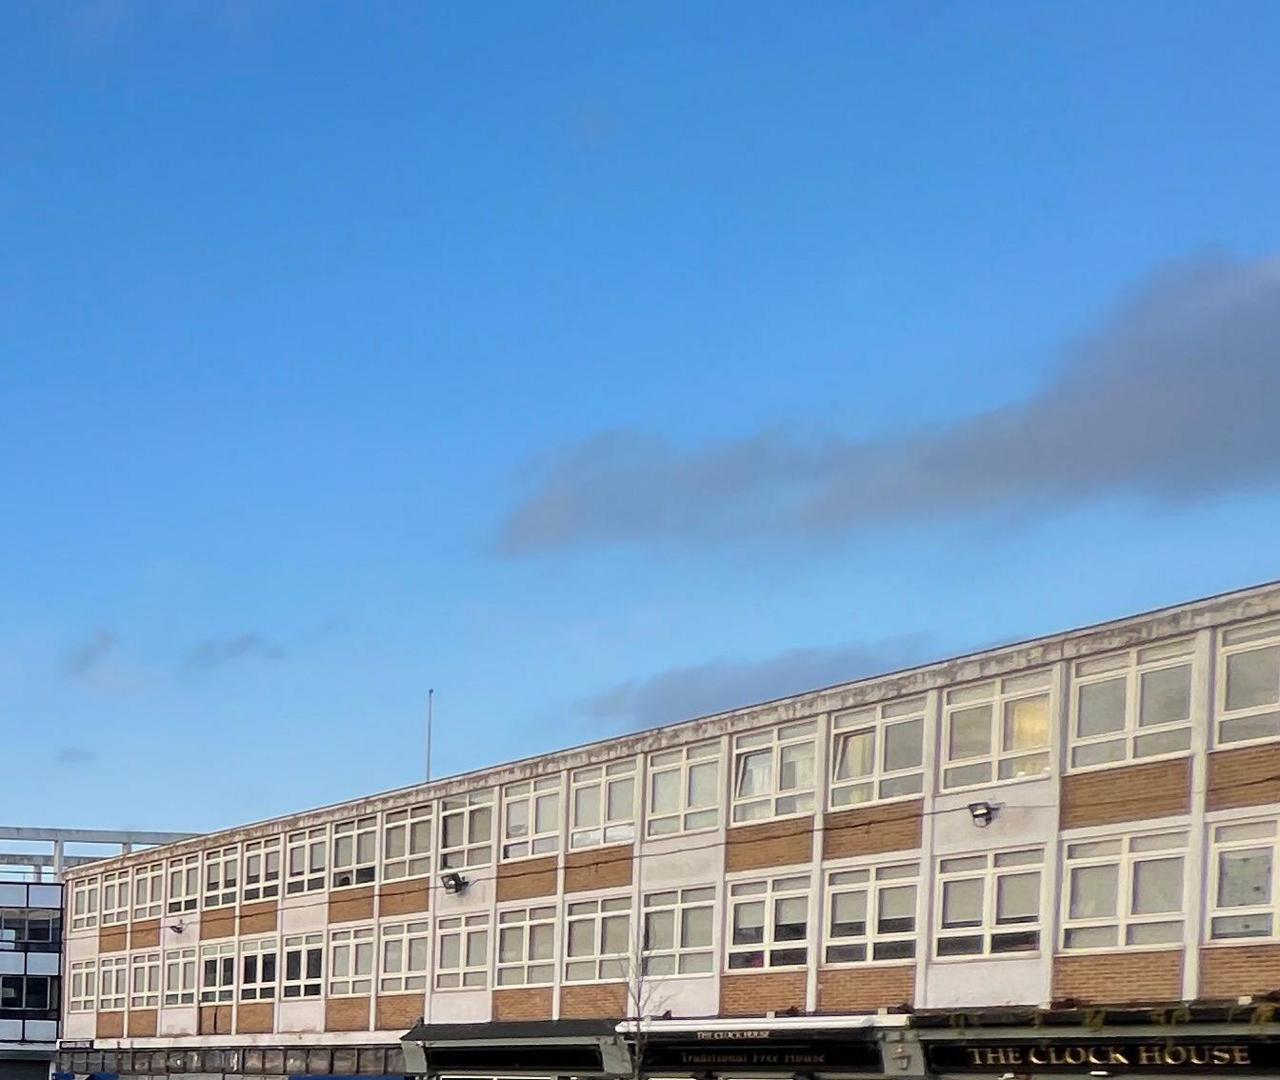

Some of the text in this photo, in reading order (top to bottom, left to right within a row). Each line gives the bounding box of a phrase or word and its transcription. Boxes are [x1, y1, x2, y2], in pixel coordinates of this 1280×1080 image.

[696, 1030, 771, 1040] THE CLOCK HOUSE
[967, 1046, 1252, 1065] THE CLOCK HOUSE
